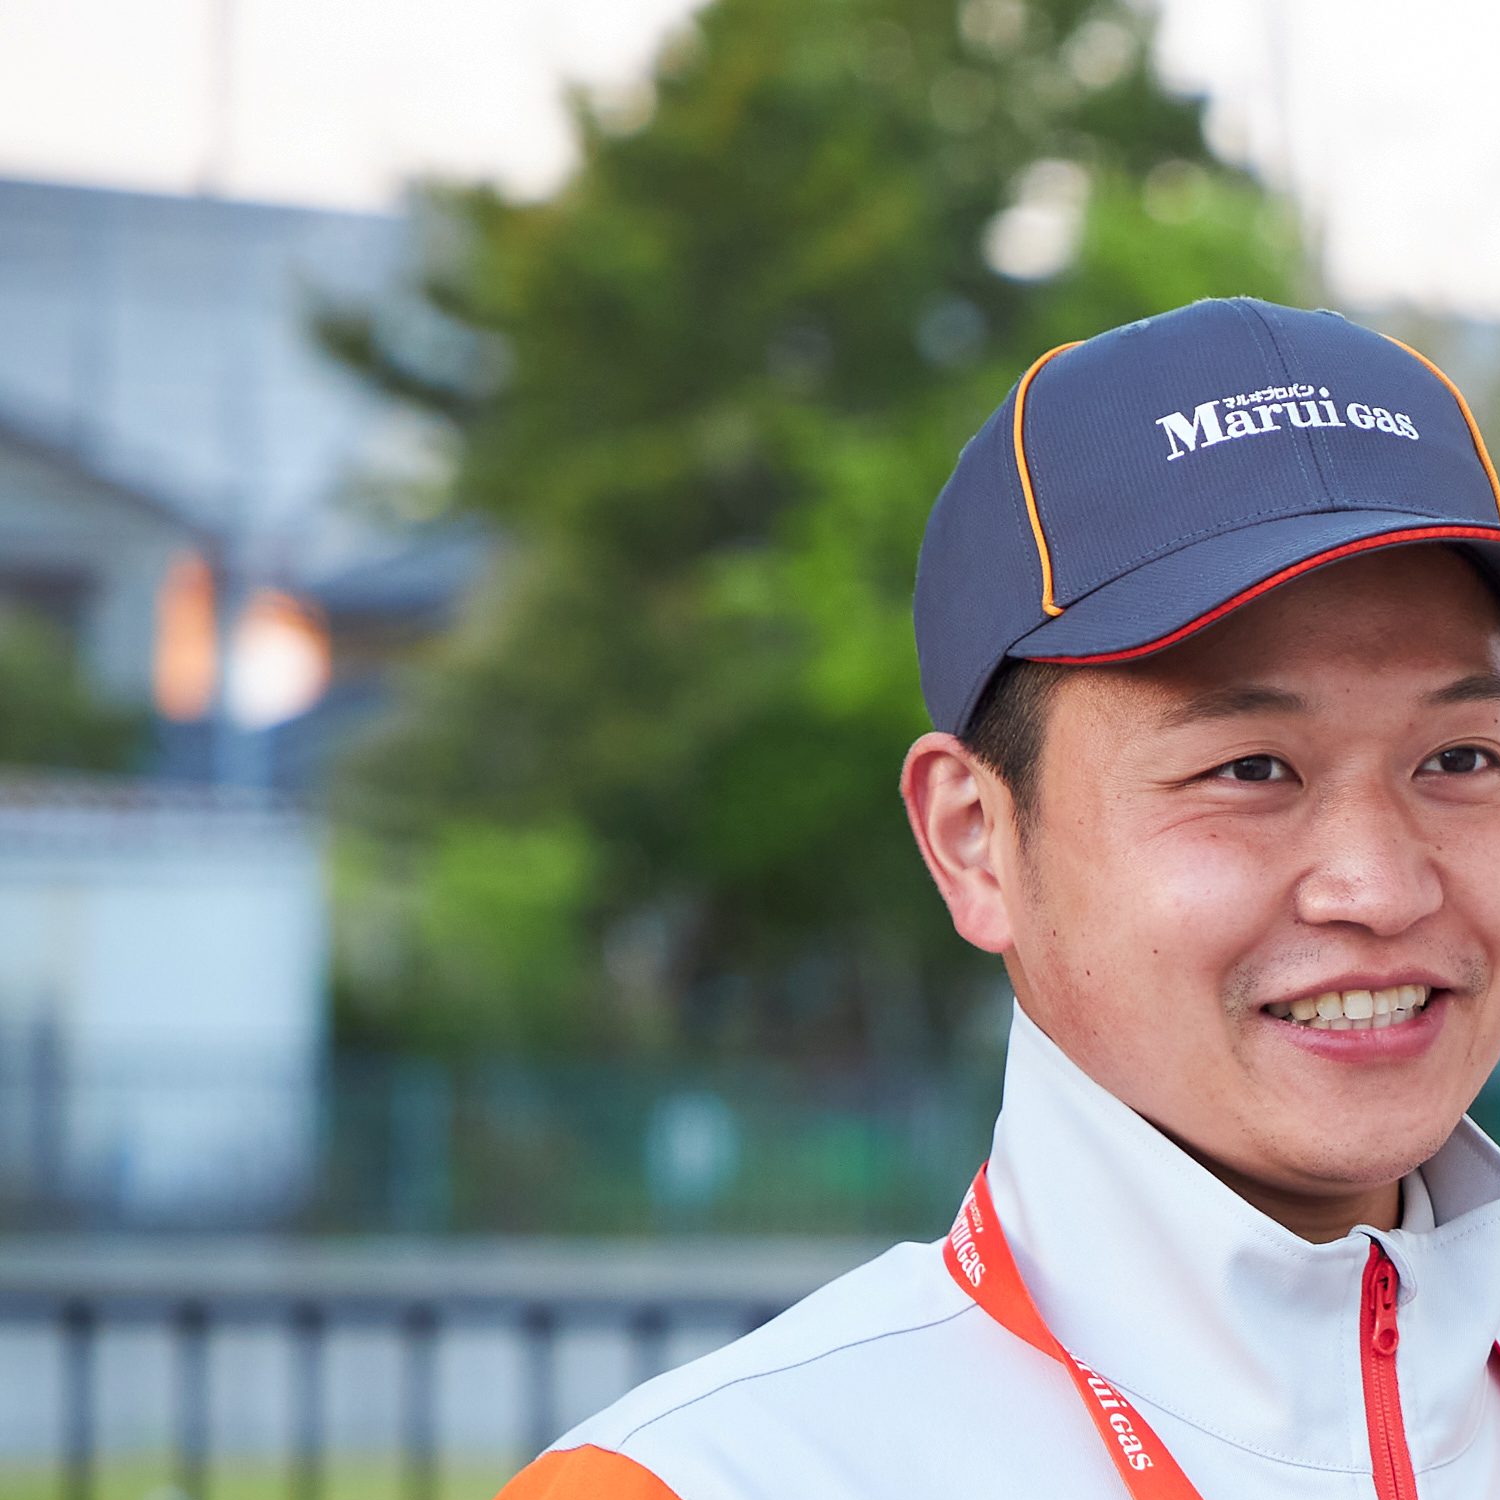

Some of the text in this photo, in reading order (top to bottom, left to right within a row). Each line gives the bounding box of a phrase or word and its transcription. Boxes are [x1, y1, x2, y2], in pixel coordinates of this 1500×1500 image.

[1155, 386, 1420, 461] Marui Gas
[957, 1241, 986, 1288] Gas
[1109, 1412, 1154, 1471] Gas
